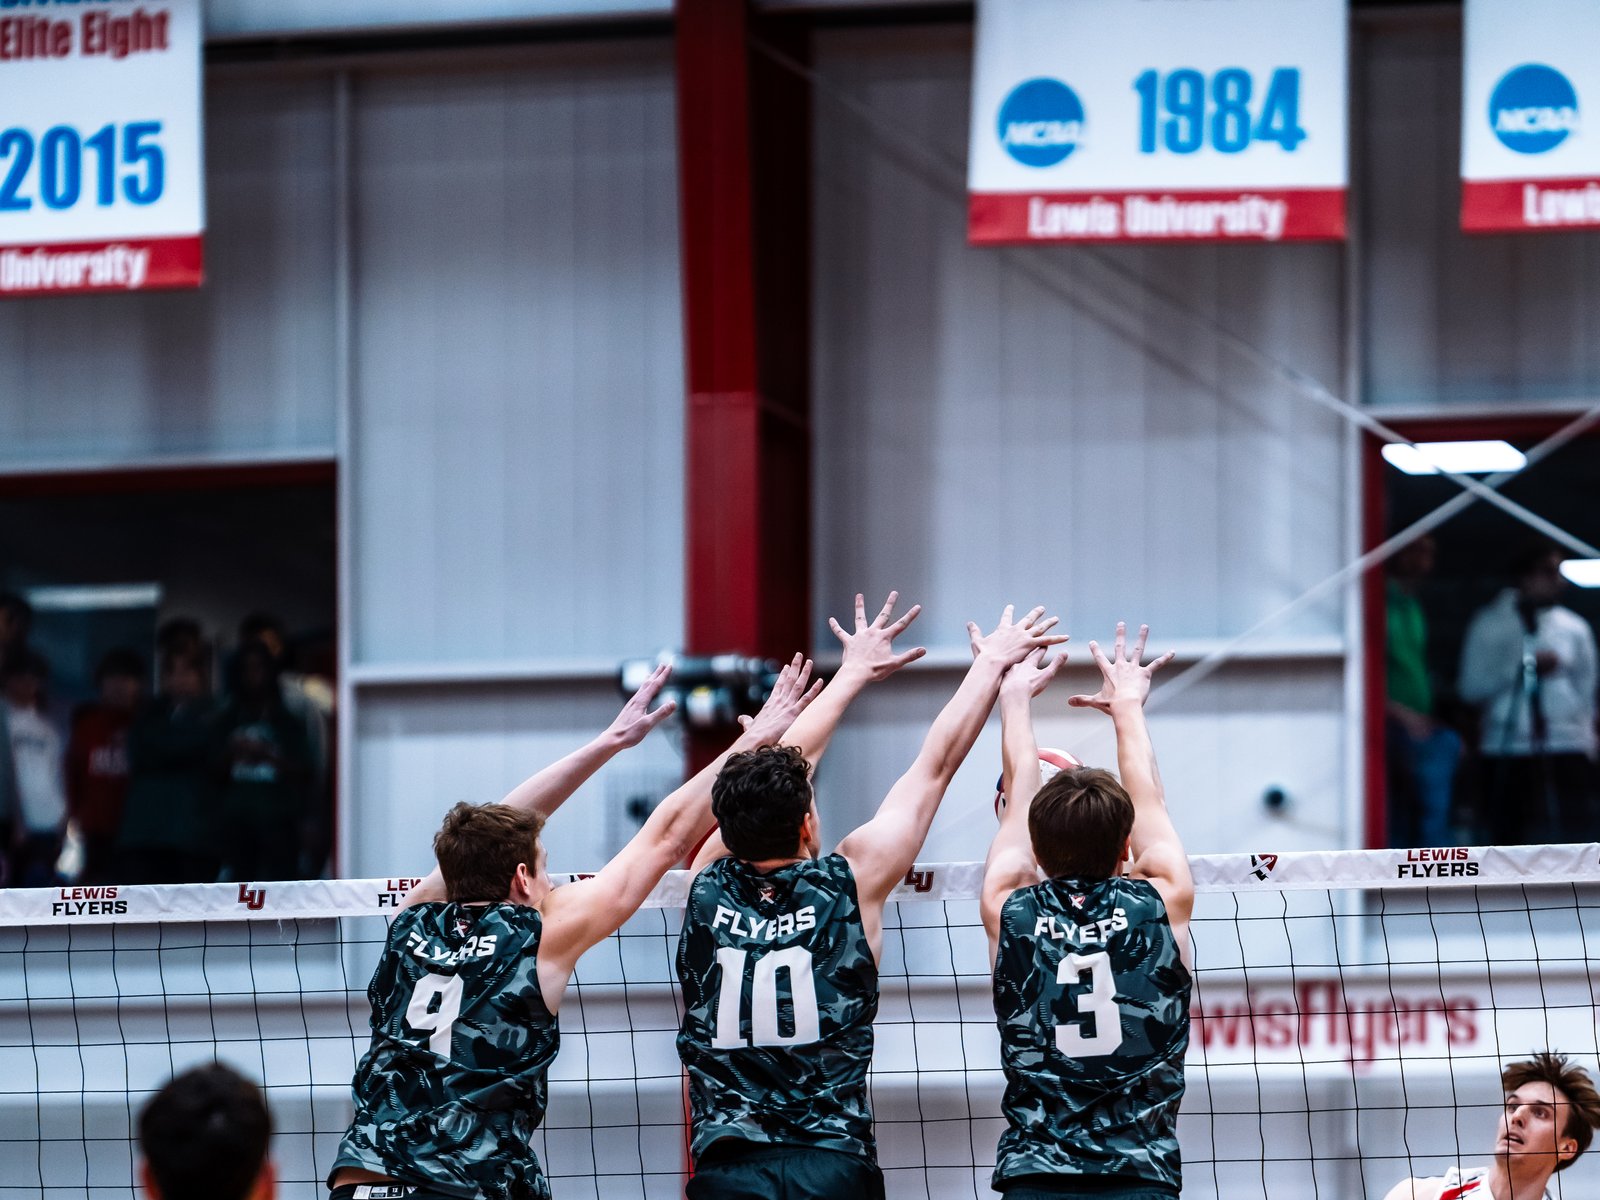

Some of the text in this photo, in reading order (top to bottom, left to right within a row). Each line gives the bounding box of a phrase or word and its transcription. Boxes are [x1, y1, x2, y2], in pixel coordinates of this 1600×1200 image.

[81, 9, 169, 59] Eight
[1133, 68, 1306, 153] 1984
[0, 121, 164, 210] 2015
[1028, 195, 1285, 239] Lewis University
[0, 245, 148, 289] University
[1398, 862, 1479, 879] FLYERS
[1407, 848, 1469, 862] LEWIS
[52, 900, 128, 916] FLYERS
[61, 887, 118, 901] LEWIS
[377, 893, 406, 907] FL
[712, 904, 816, 941] FLYERS
[1034, 907, 1128, 944] FLYERS
[406, 931, 497, 966] FLYERS
[405, 973, 464, 1058] 9
[711, 945, 820, 1049] 10
[1054, 950, 1123, 1058] 3
